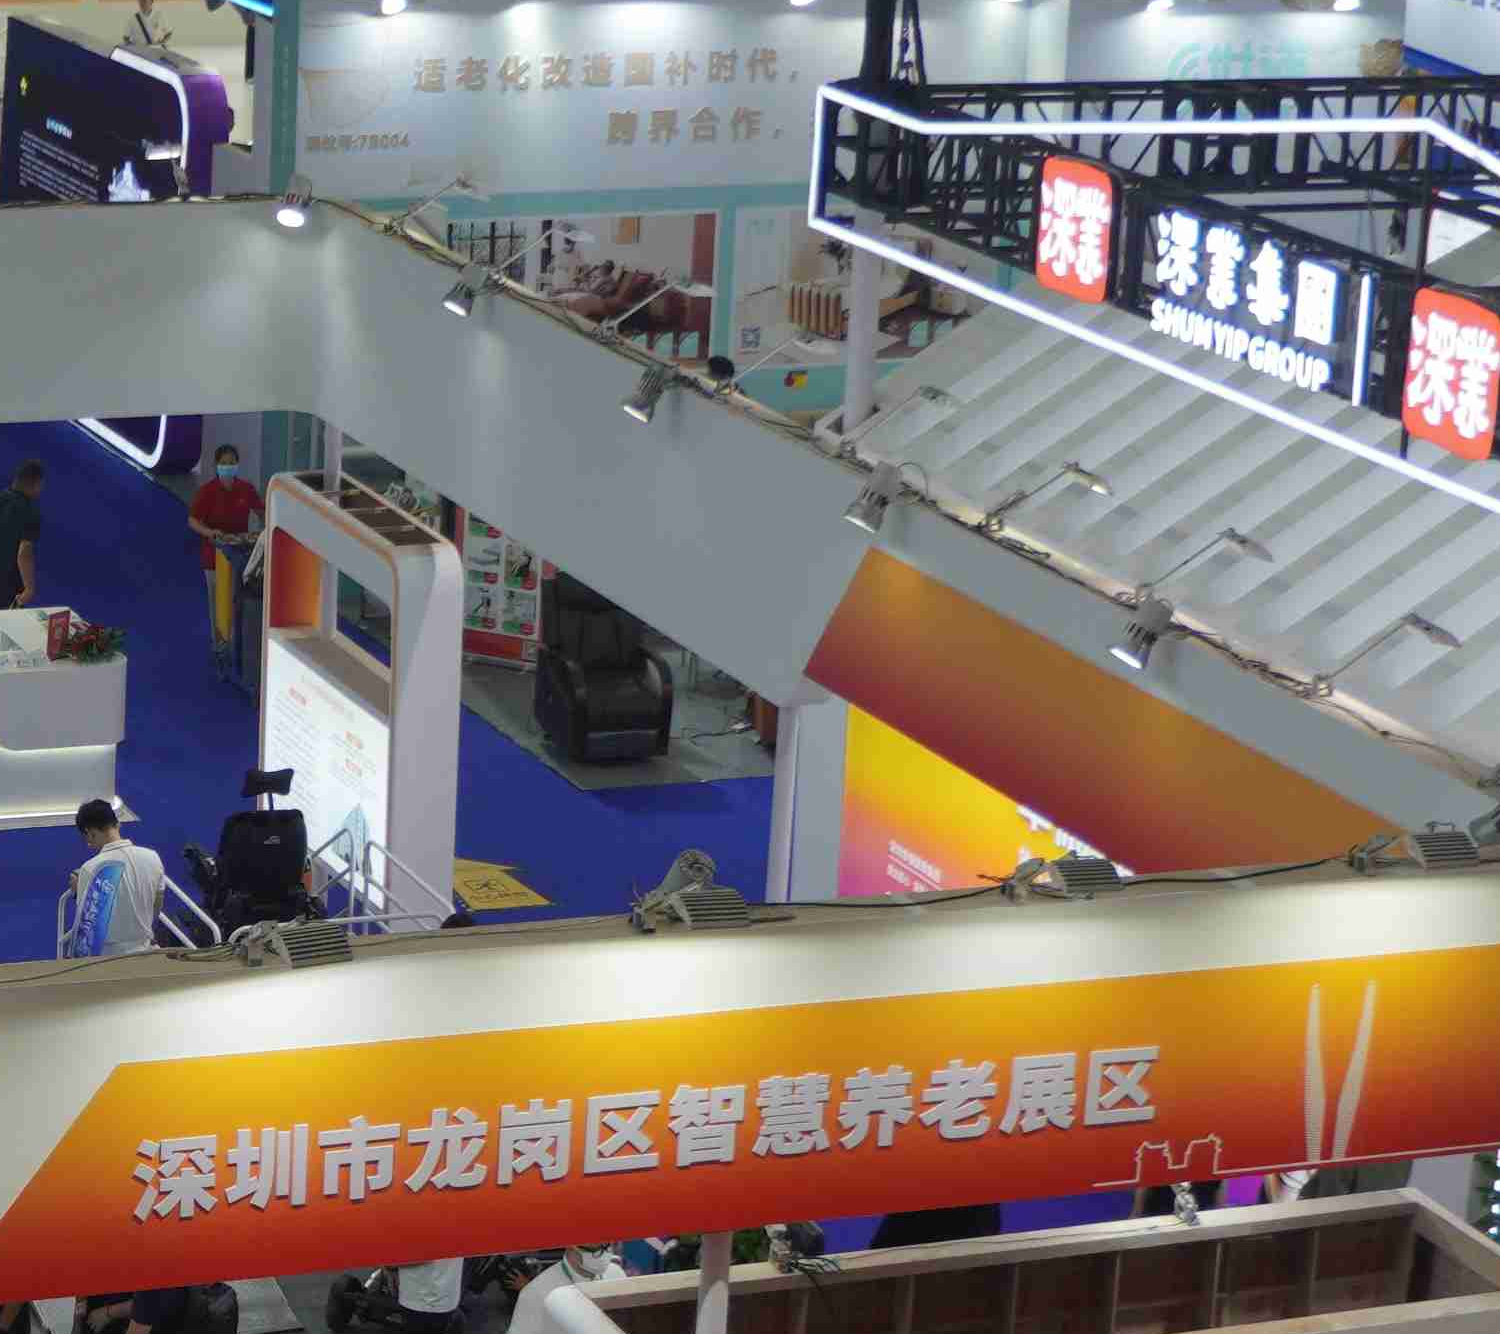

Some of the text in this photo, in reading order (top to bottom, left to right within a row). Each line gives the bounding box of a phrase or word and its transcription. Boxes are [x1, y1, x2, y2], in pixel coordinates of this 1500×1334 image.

[1247, 335, 1331, 393] GROUP
[131, 1043, 1163, 1225] 深圳市龙岗区智慧养老展区
